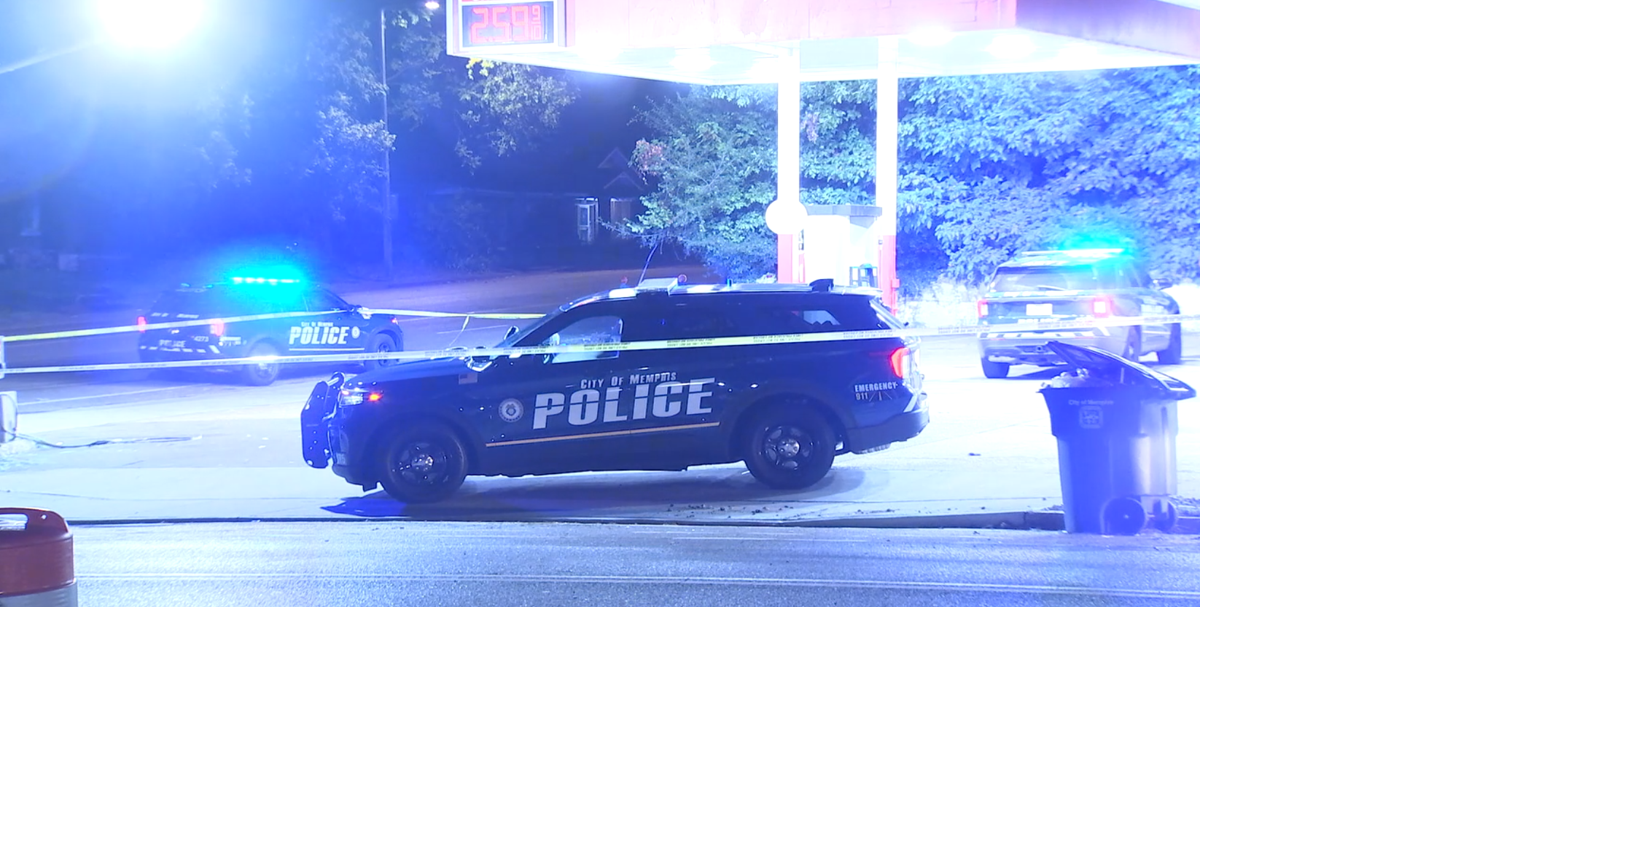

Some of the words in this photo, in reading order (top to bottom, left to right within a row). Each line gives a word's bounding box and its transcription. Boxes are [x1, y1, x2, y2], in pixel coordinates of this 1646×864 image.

[288, 326, 350, 344] POLICE
[580, 379, 604, 389] CITY
[611, 376, 624, 386] OF
[629, 371, 677, 385] MEMPHIS
[532, 377, 716, 430] POLICE
